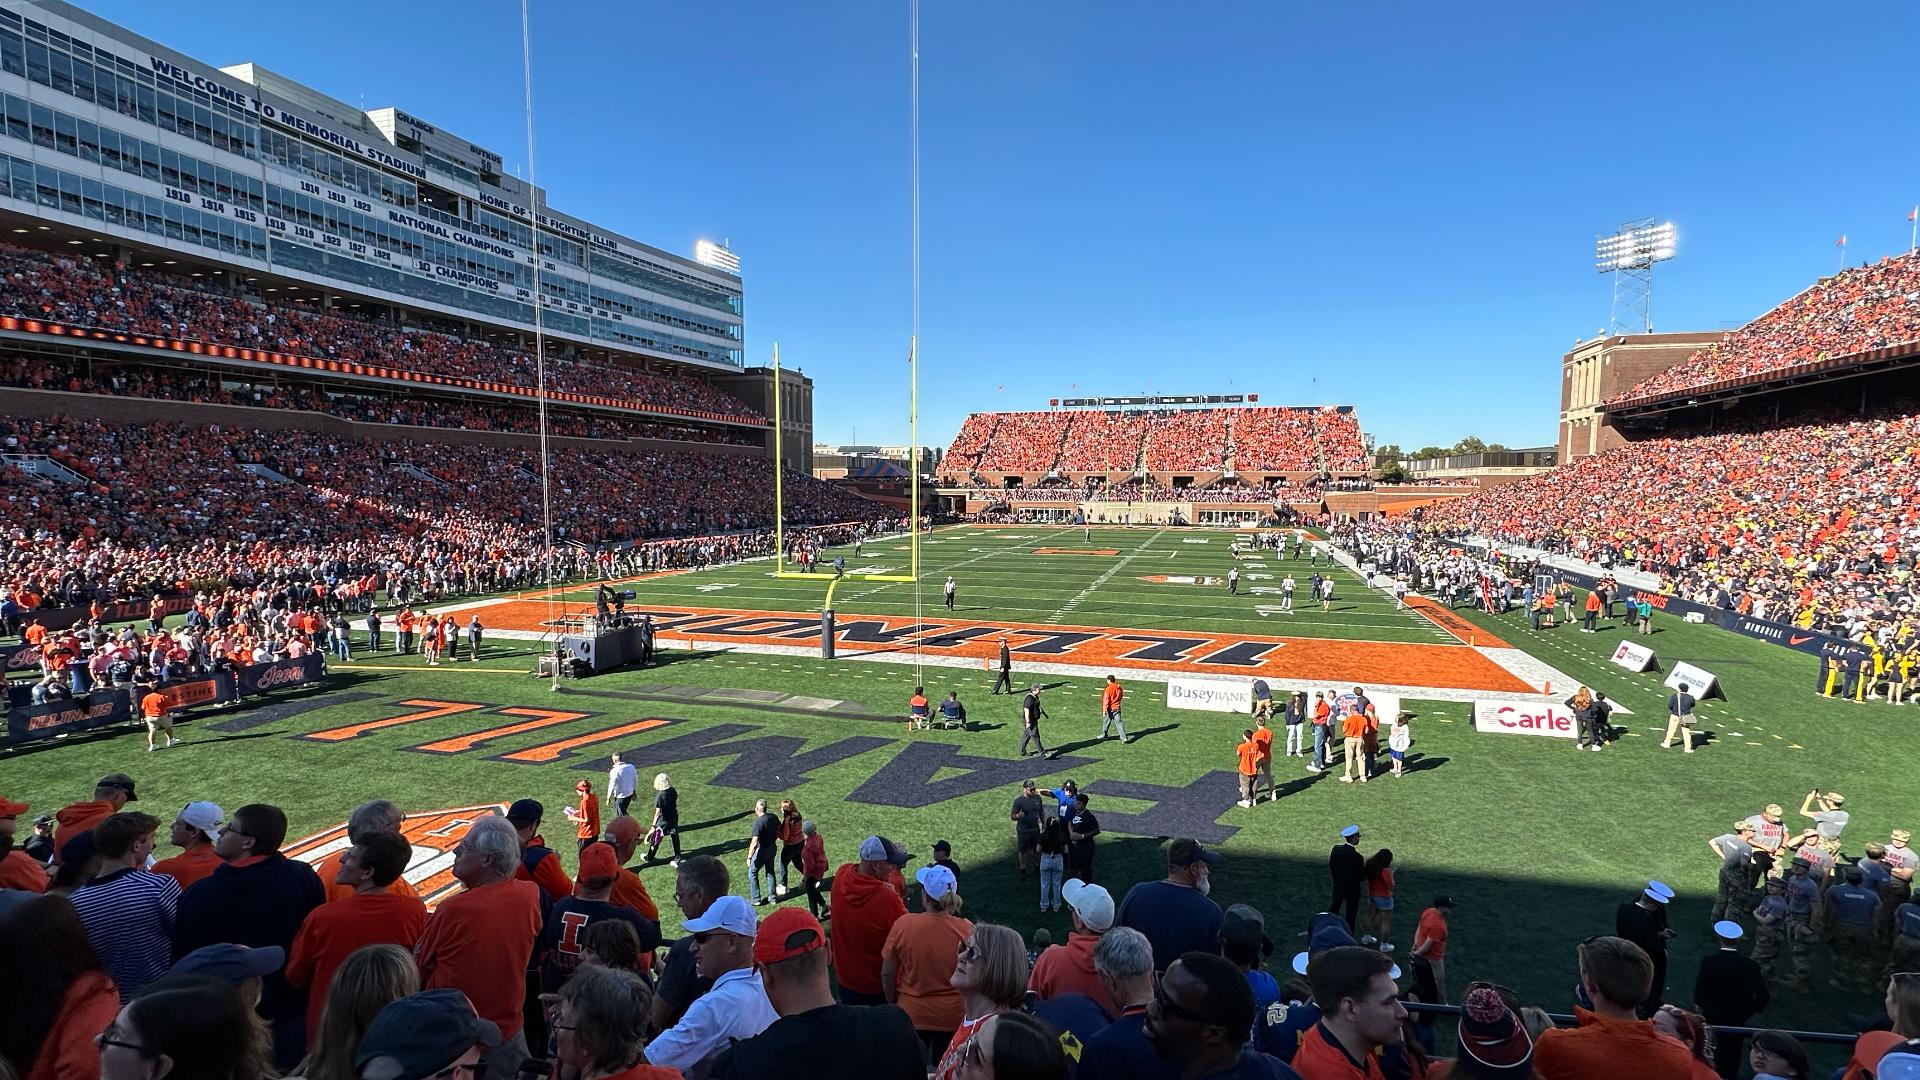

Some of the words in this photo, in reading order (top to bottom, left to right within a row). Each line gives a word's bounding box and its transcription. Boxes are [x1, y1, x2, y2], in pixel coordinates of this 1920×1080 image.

[150, 56, 246, 107] WELCOME
[250, 98, 275, 118] TO
[281, 111, 363, 154] MEMORIAL
[367, 147, 426, 179] STADIUM
[396, 112, 434, 135] GRANGE
[470, 144, 502, 164] BUTKUS
[481, 159, 491, 173] 50
[300, 180, 320, 195] 1914
[353, 198, 371, 212] 1923
[389, 210, 450, 239] NATIONAL
[452, 232, 515, 259] CHAMPIONS
[479, 192, 510, 211] HOME
[513, 205, 526, 216] OF
[550, 219, 591, 240] FIGHTING
[593, 235, 618, 250] ILLINI
[200, 197, 225, 213] 1914
[234, 207, 256, 222] 1915
[264, 216, 286, 231] 1918
[294, 225, 315, 239] 1919
[322, 233, 341, 247] 1923
[348, 241, 366, 254] 1927
[435, 265, 499, 290] CHAMPIONS
[1744, 621, 1783, 639] MEMORIAL
[1497, 706, 1571, 731] Carle
[558, 911, 589, 956] I
